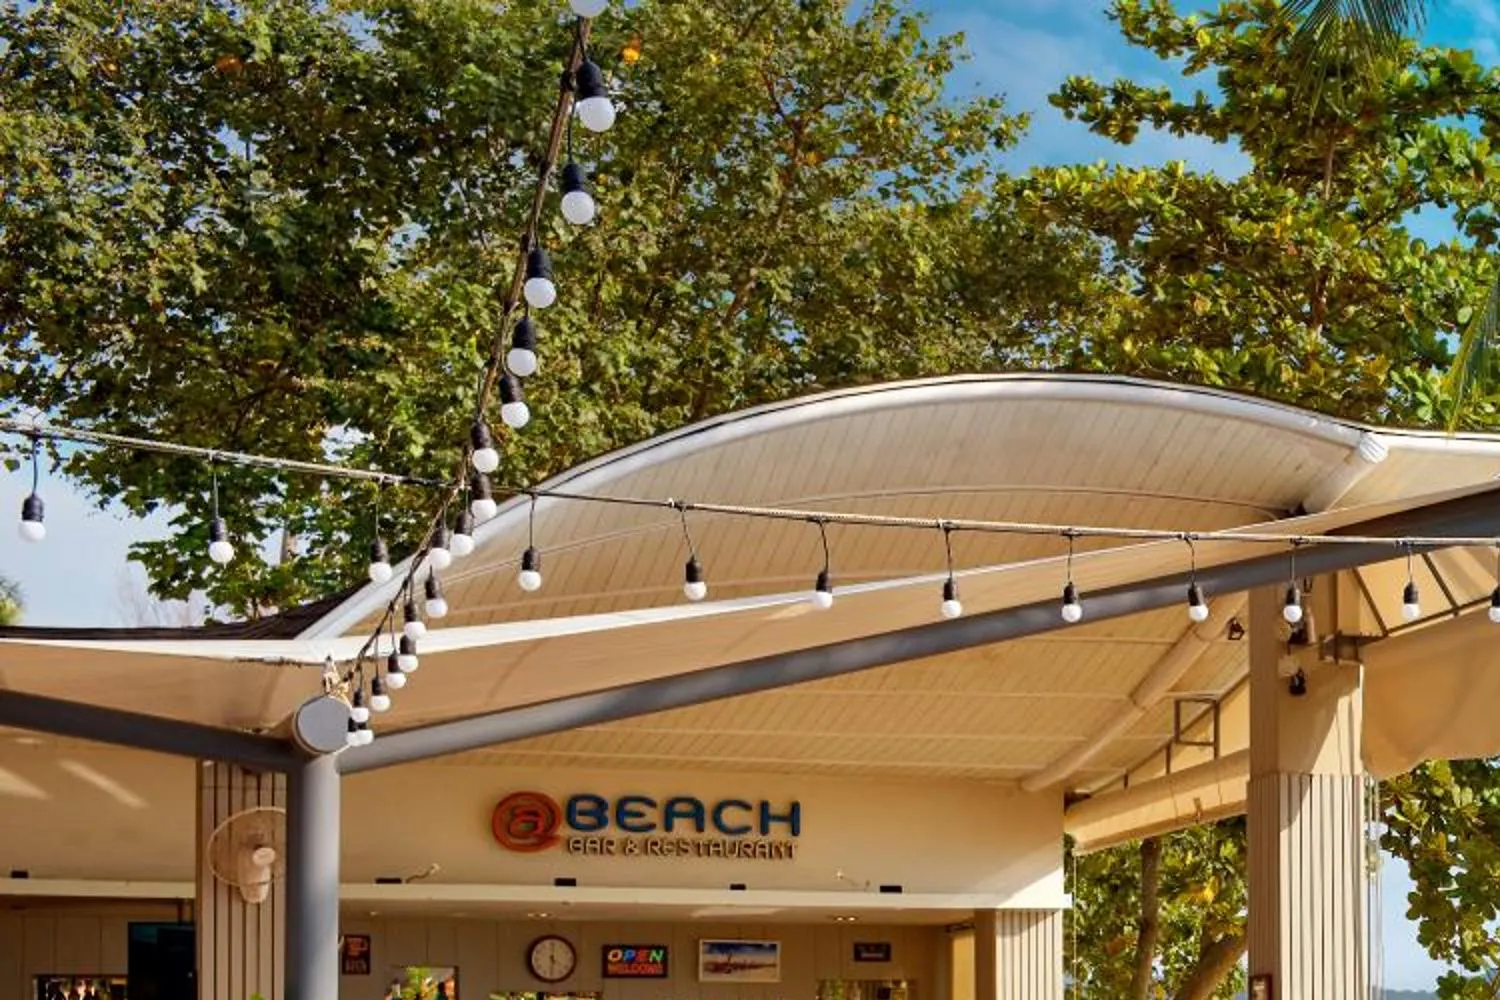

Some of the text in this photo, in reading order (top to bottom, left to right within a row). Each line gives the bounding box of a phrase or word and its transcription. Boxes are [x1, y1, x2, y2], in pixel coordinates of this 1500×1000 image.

[566, 794, 800, 836] BEACH
[569, 837, 796, 859] BAR & RESTAURANT
[607, 949, 664, 962] OPEN
